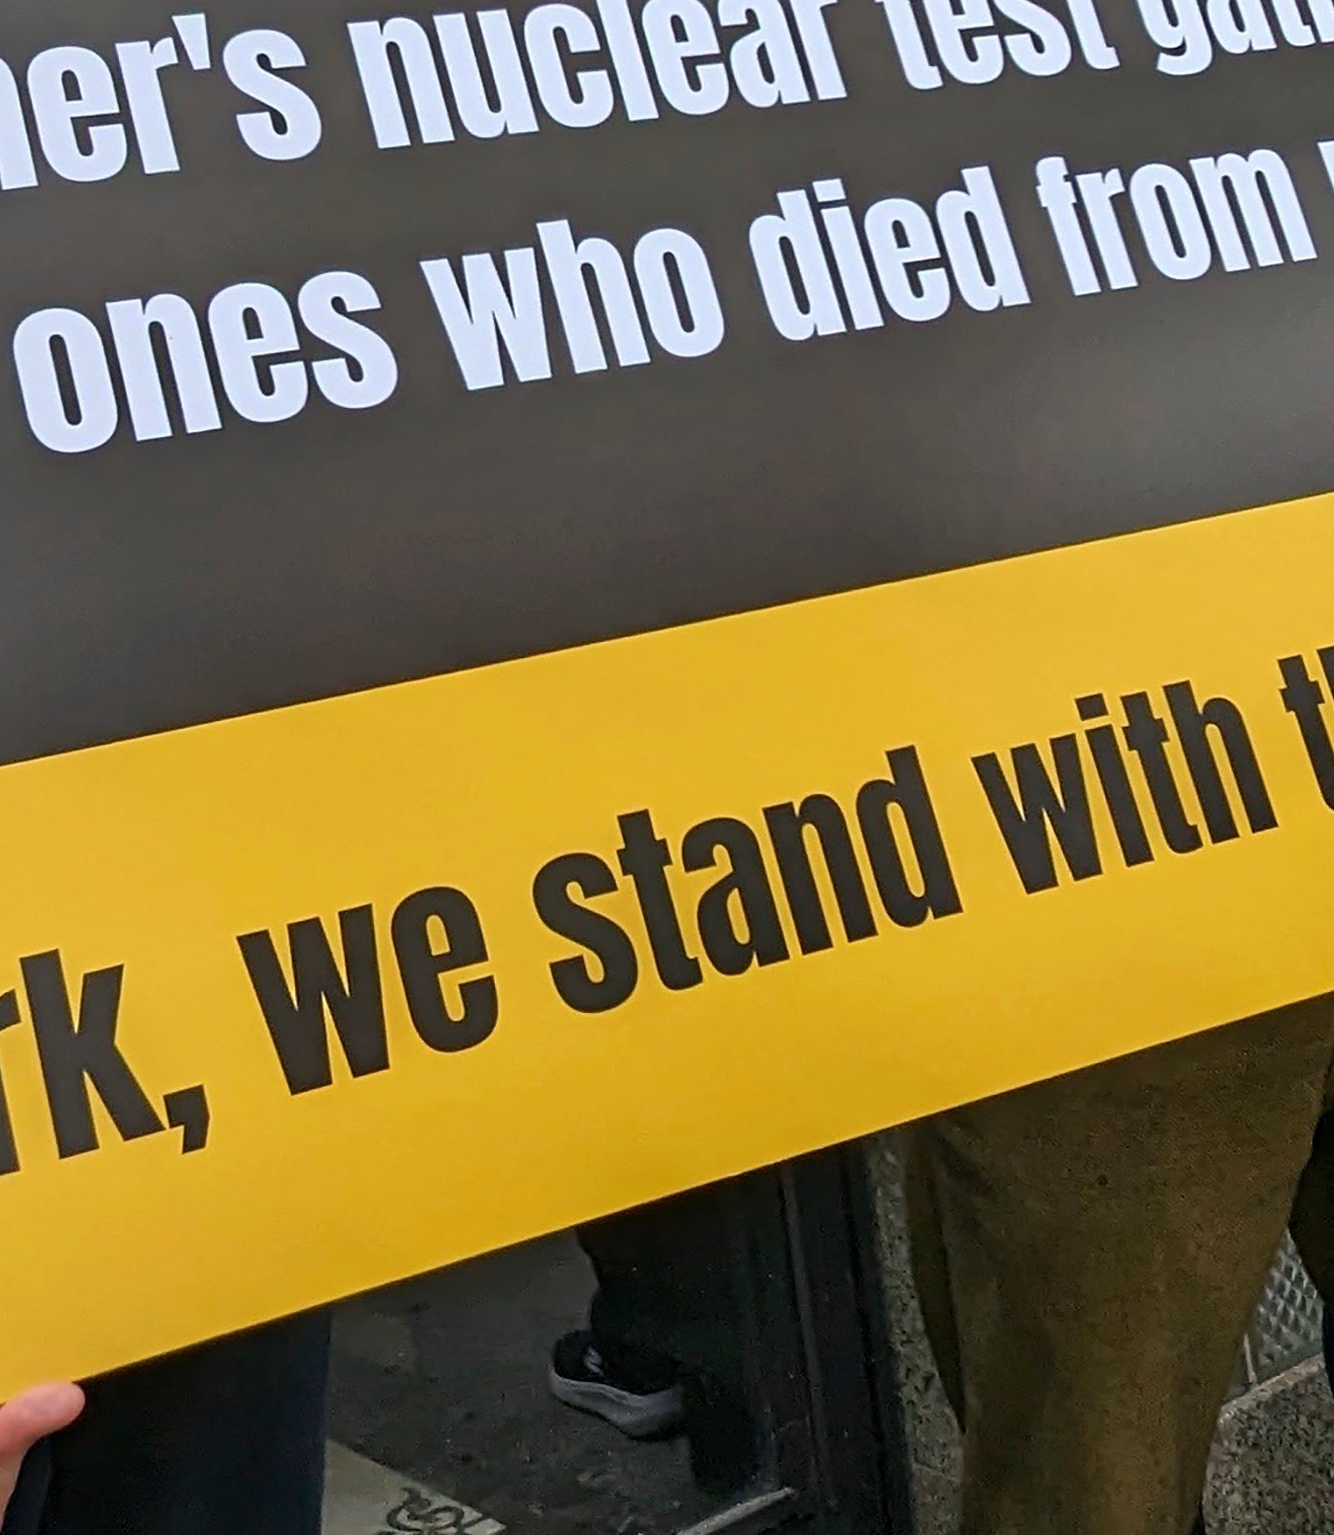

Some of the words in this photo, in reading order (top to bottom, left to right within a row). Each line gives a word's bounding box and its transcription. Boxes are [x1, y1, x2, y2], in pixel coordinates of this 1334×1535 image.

[12, 270, 399, 454] ones
[418, 218, 725, 392] who
[748, 164, 1032, 342] died
[1035, 148, 1318, 297] from
[235, 885, 500, 1097] we
[531, 743, 965, 1015] stand
[969, 679, 1280, 896] with
